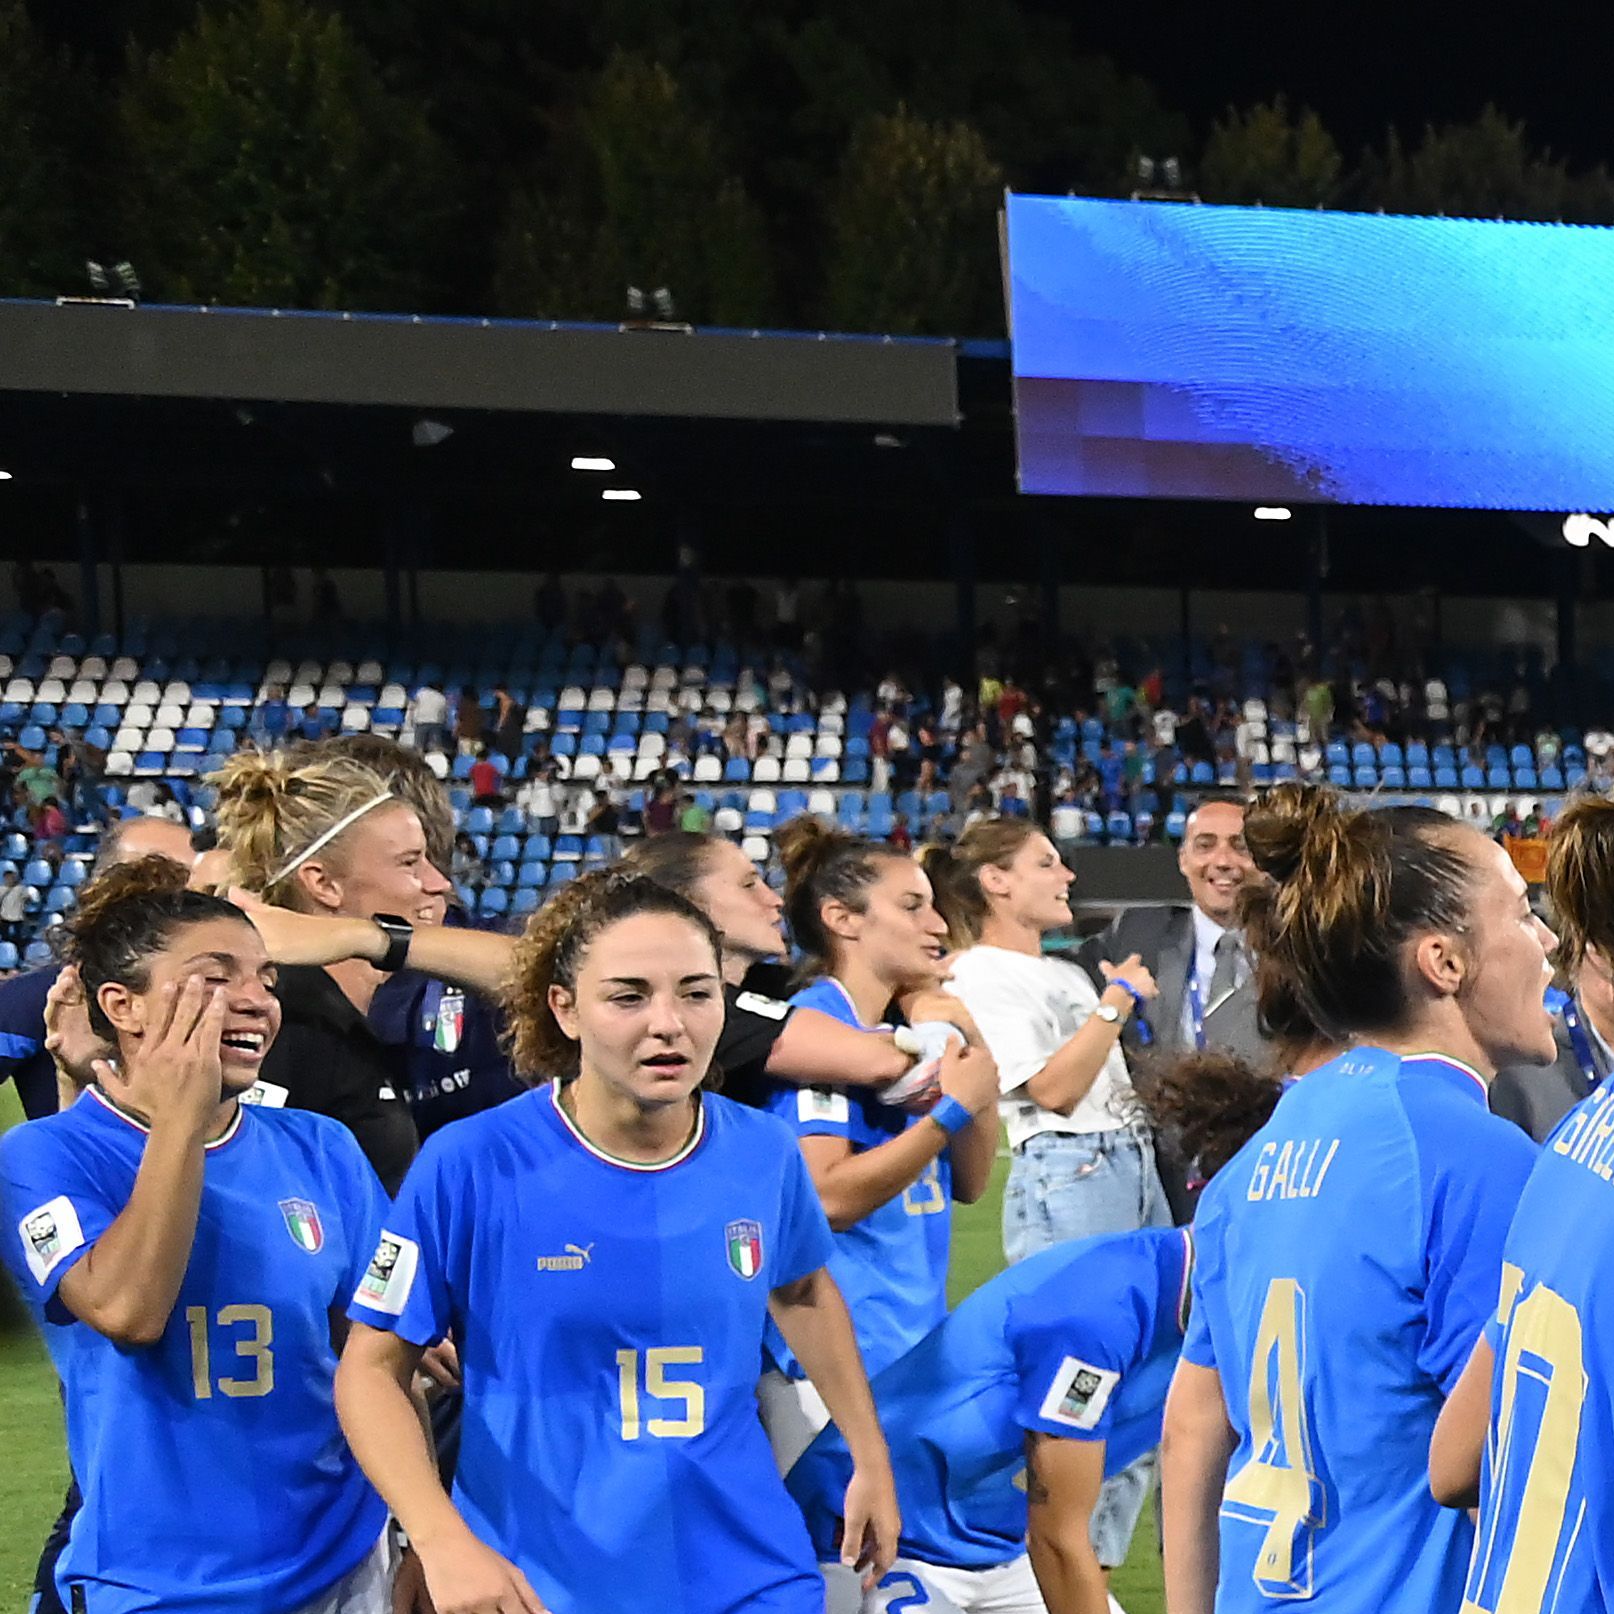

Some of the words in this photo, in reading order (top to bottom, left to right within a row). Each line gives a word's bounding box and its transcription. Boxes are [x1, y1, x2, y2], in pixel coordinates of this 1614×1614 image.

[1247, 1138, 1341, 1202] GALLI
[185, 1303, 275, 1400] 13
[616, 1345, 705, 1441] 15
[1220, 1278, 1328, 1600] 4
